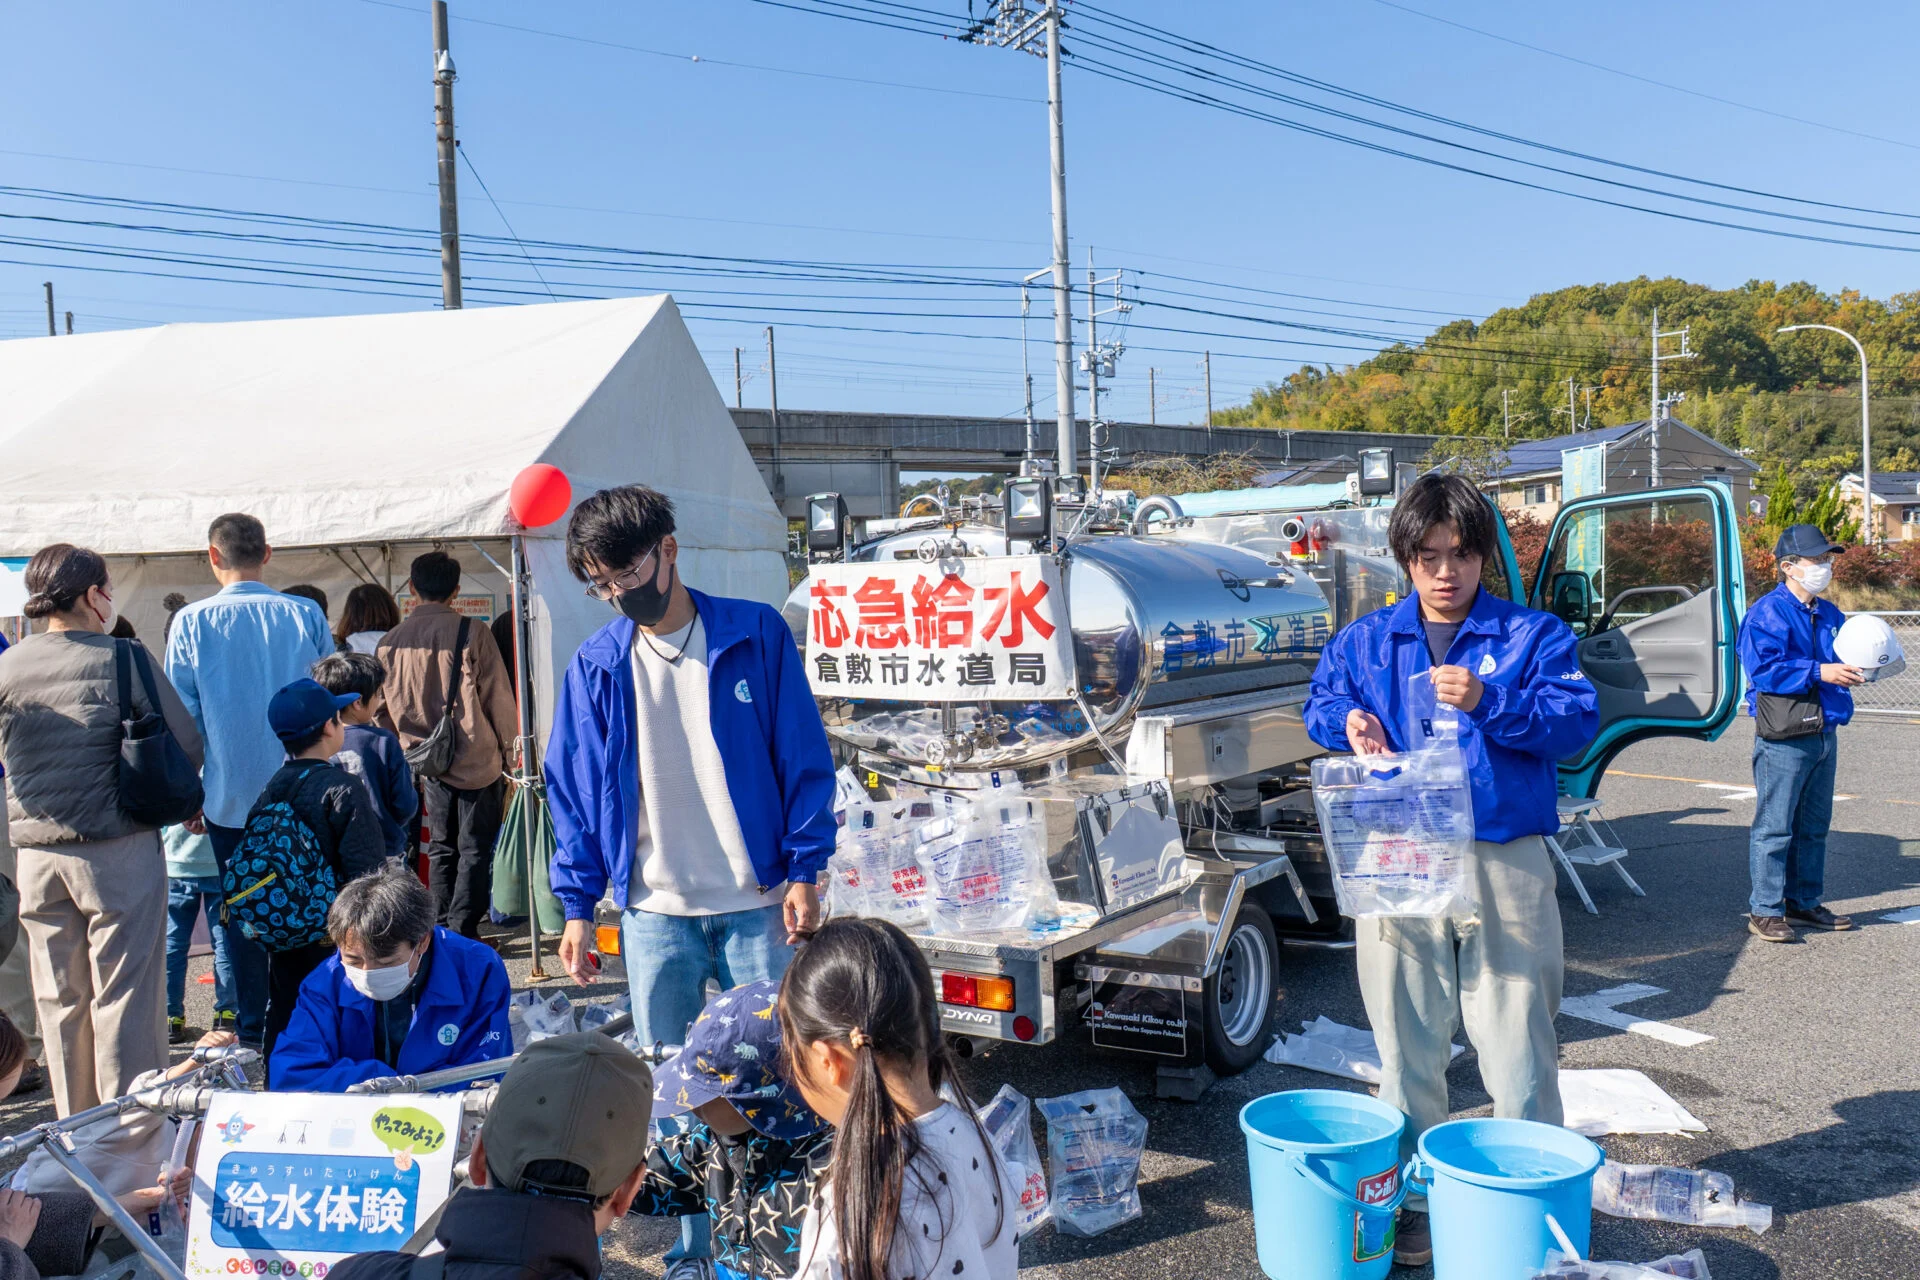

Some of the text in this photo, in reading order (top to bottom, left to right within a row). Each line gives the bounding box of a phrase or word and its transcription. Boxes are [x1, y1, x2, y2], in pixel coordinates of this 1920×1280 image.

[810, 571, 1056, 649] 応急給水
[1160, 615, 1329, 673] 倉敷市水道局
[814, 652, 1047, 687] 倉敷市水道局
[943, 1008, 993, 1024] DYNA
[1104, 1010, 1140, 1022] Kawasaki
[1142, 1014, 1164, 1025] Kikou
[375, 1112, 446, 1149] やってみよう!
[231, 1163, 405, 1181] きゅうすいたいけん
[221, 1180, 408, 1235] 給水体験
[226, 1257, 297, 1277] くらしきし
